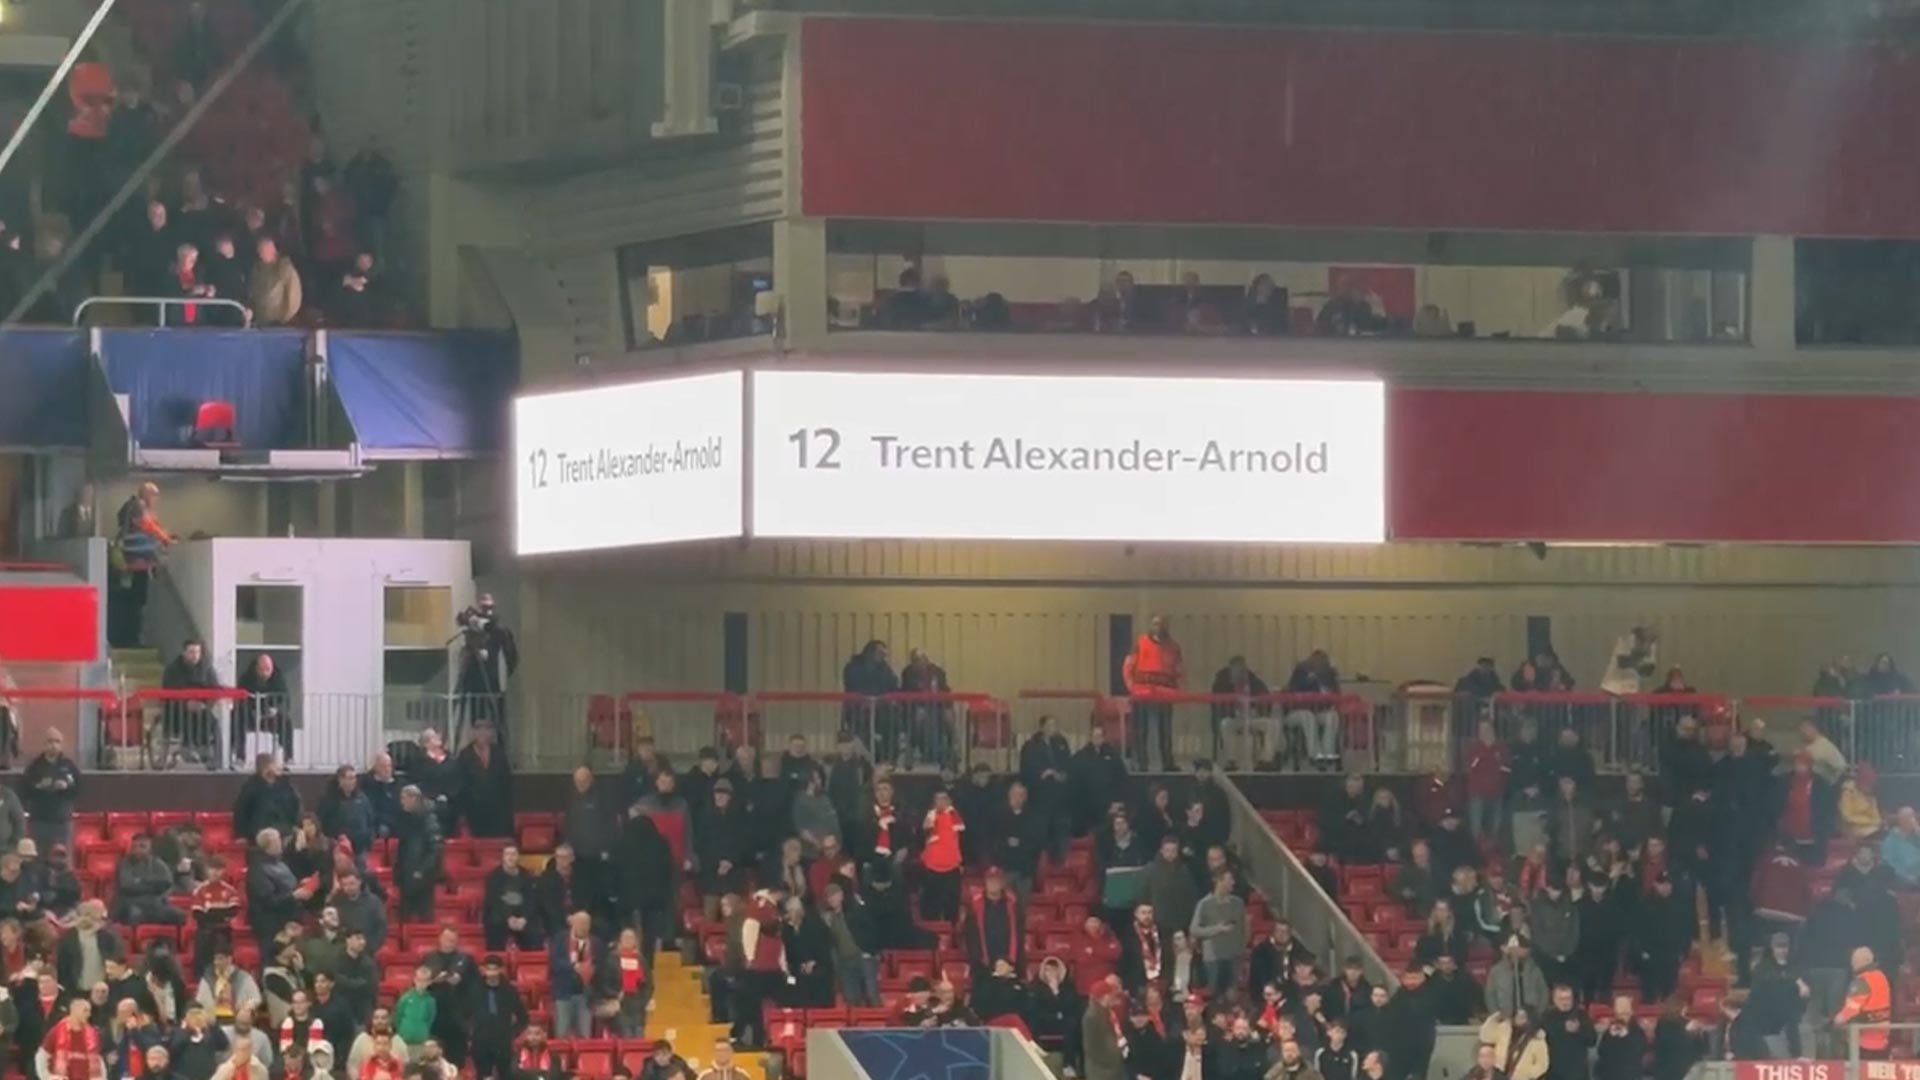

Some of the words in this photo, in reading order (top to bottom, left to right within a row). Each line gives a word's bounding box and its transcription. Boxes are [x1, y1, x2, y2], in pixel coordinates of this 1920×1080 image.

[529, 447, 548, 489] 12
[556, 452, 595, 484] Trent
[596, 435, 722, 480] Alexander-Arnold
[789, 427, 842, 470] 12
[870, 435, 975, 470] Trent
[982, 437, 1329, 474] Alexander-Arnold
[1754, 1064, 1803, 1080] THIS
[1810, 1064, 1829, 1080] IS
